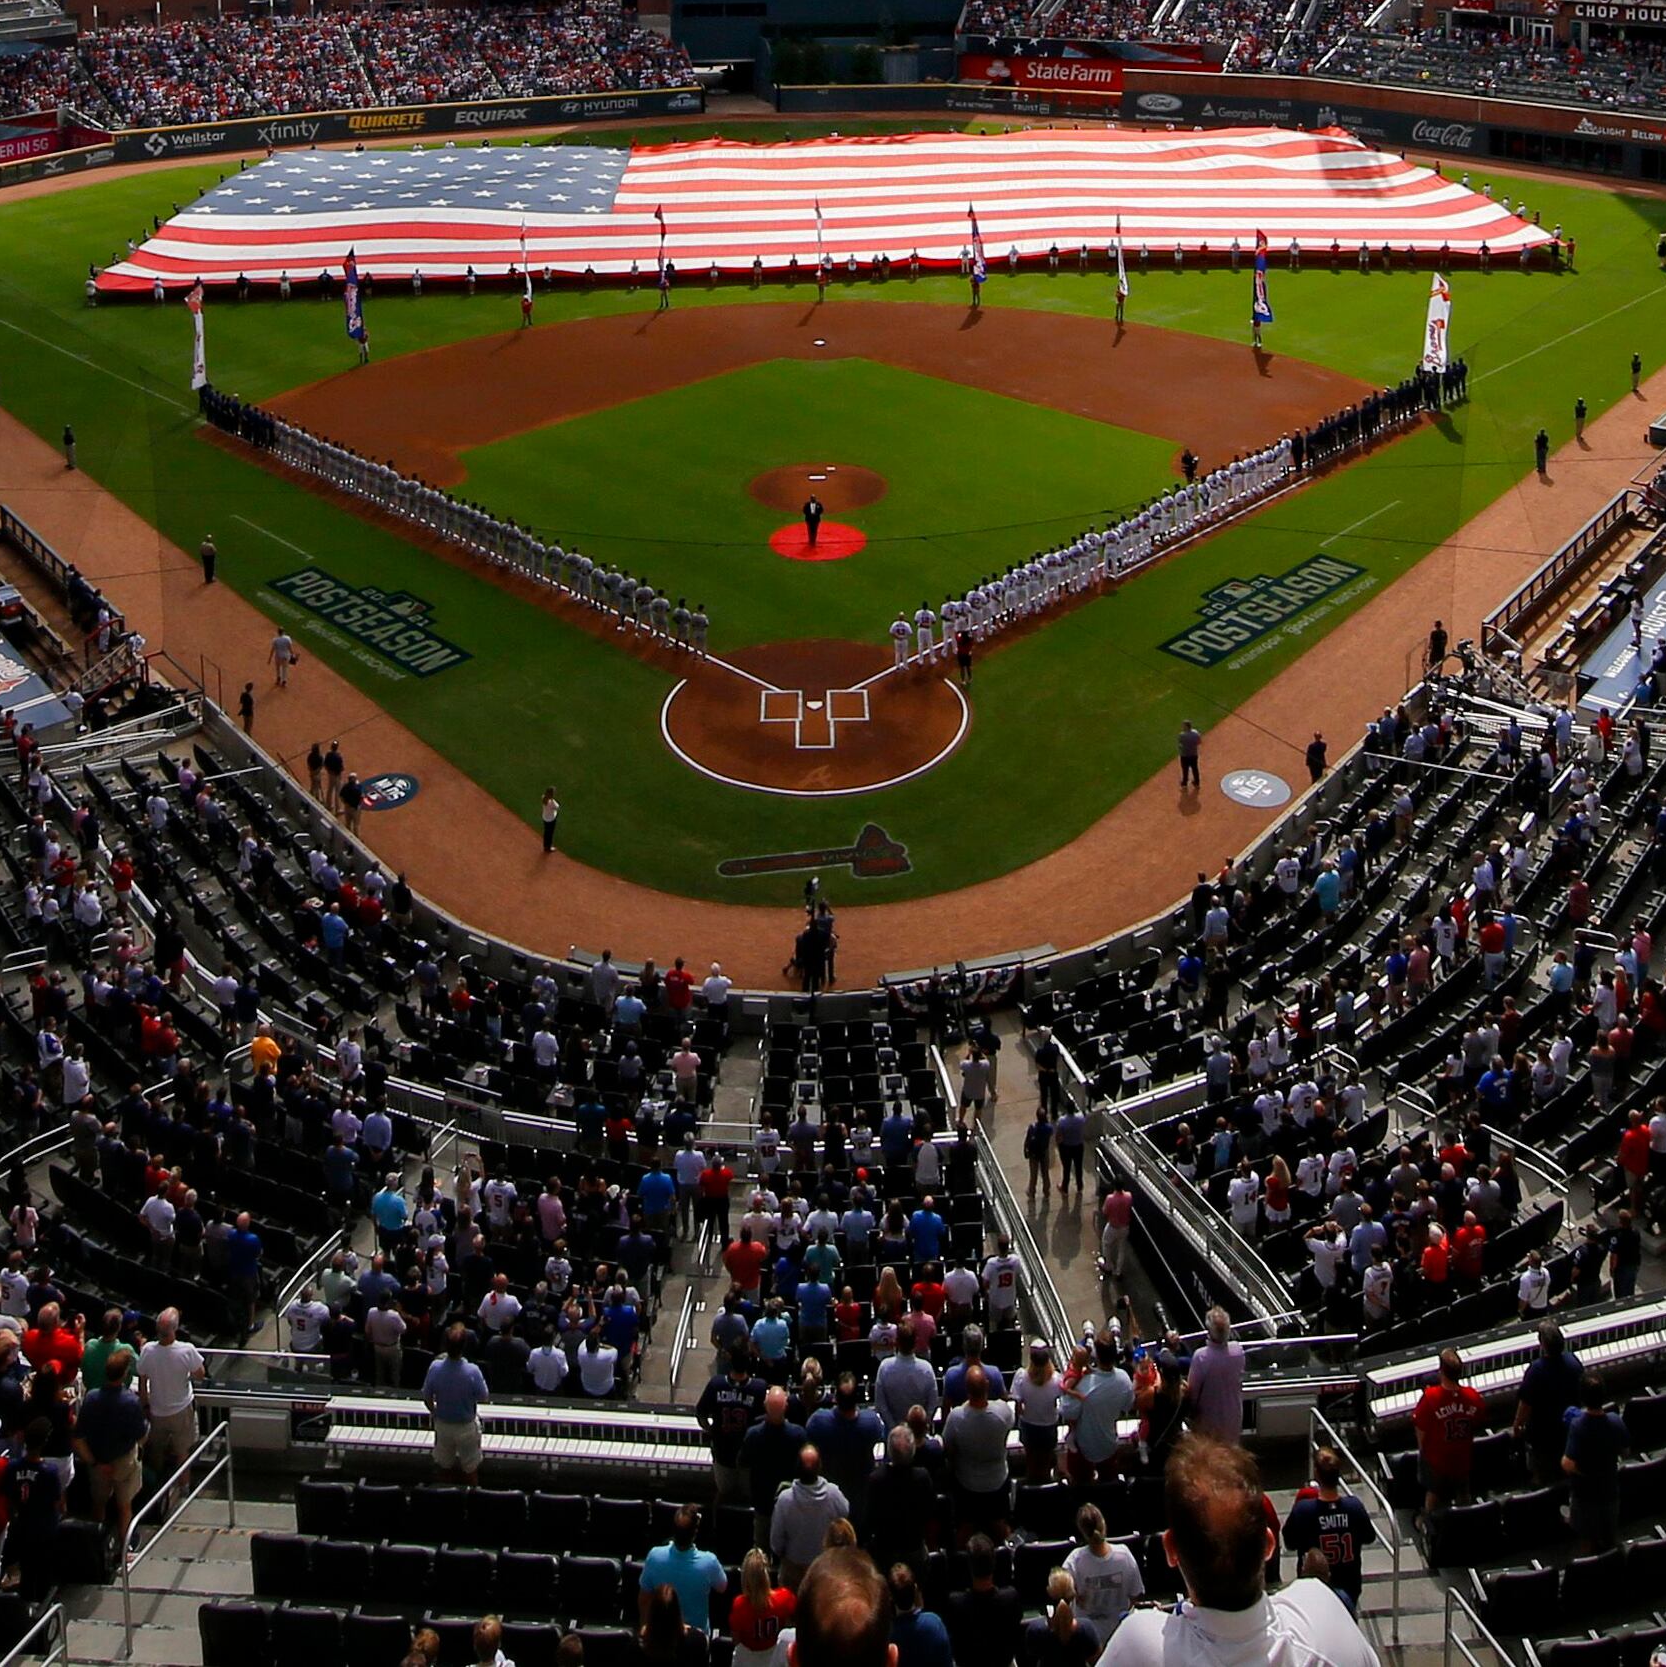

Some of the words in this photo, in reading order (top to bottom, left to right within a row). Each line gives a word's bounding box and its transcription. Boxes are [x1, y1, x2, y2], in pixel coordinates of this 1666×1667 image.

[1575, 3, 1618, 20] CHOP
[584, 99, 639, 111] HYUNDAI
[1013, 103, 1038, 112] TRUIST
[349, 112, 427, 129] QUIKRETE
[454, 107, 532, 125] EQUIFAX
[1218, 107, 1257, 121] Georgia
[1259, 109, 1290, 121] Power
[171, 131, 226, 145] Wellstar
[257, 120, 321, 144] xfinity
[17, 141, 31, 156] IN
[32, 138, 50, 153] 5G
[361, 588, 385, 602] 20
[1168, 558, 1359, 664] POSTSEASON
[1201, 602, 1227, 617] 20
[276, 570, 462, 674] POSTSEASON
[1303, 1096, 1312, 1109] 5
[494, 1194, 503, 1207] 5
[1318, 1513, 1349, 1531] SMITH
[1319, 1531, 1355, 1565] 51
